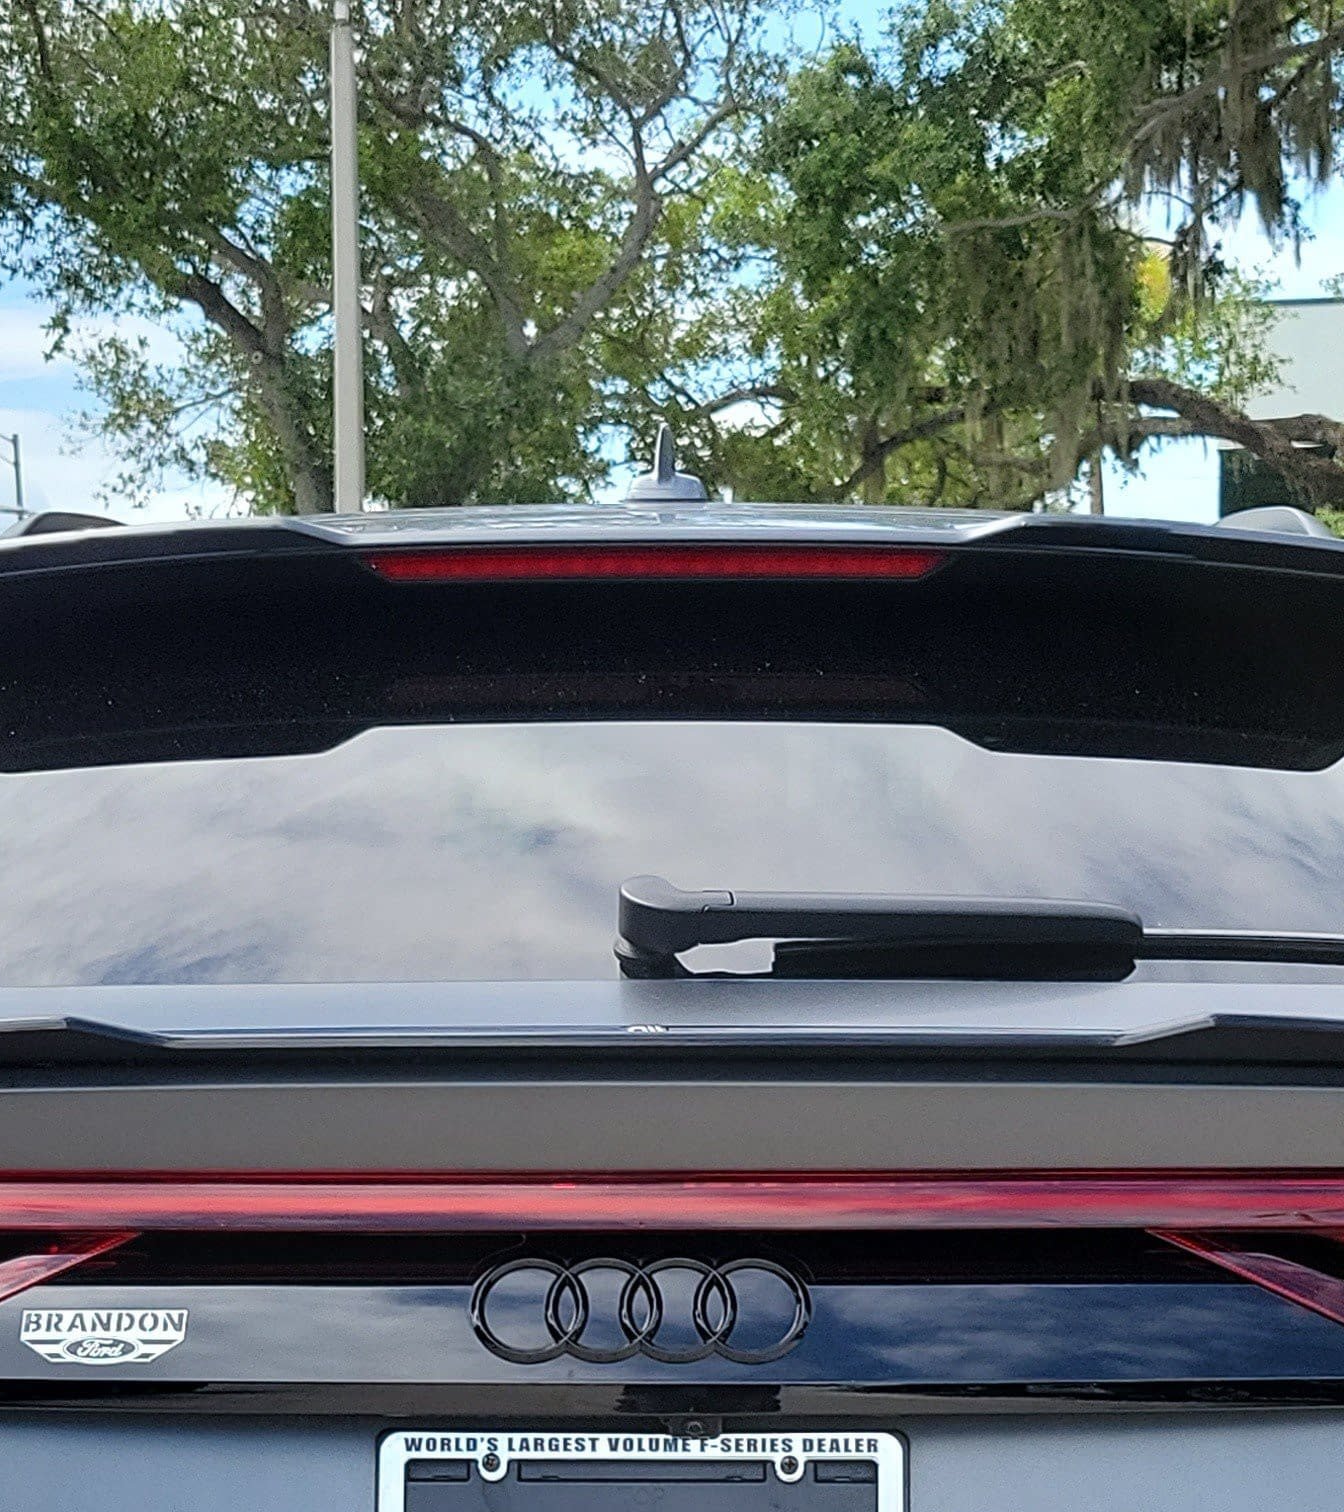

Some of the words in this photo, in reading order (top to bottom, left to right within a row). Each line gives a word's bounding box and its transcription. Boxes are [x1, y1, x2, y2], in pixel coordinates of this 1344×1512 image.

[23, 1312, 185, 1333] BRANDON
[76, 1338, 125, 1358] Ford
[404, 1437, 498, 1452] WORLD'S
[507, 1437, 600, 1452] LARGEST
[607, 1437, 692, 1453] VOLUME
[700, 1438, 794, 1453] F-SERIES
[802, 1438, 879, 1453] DEALER
